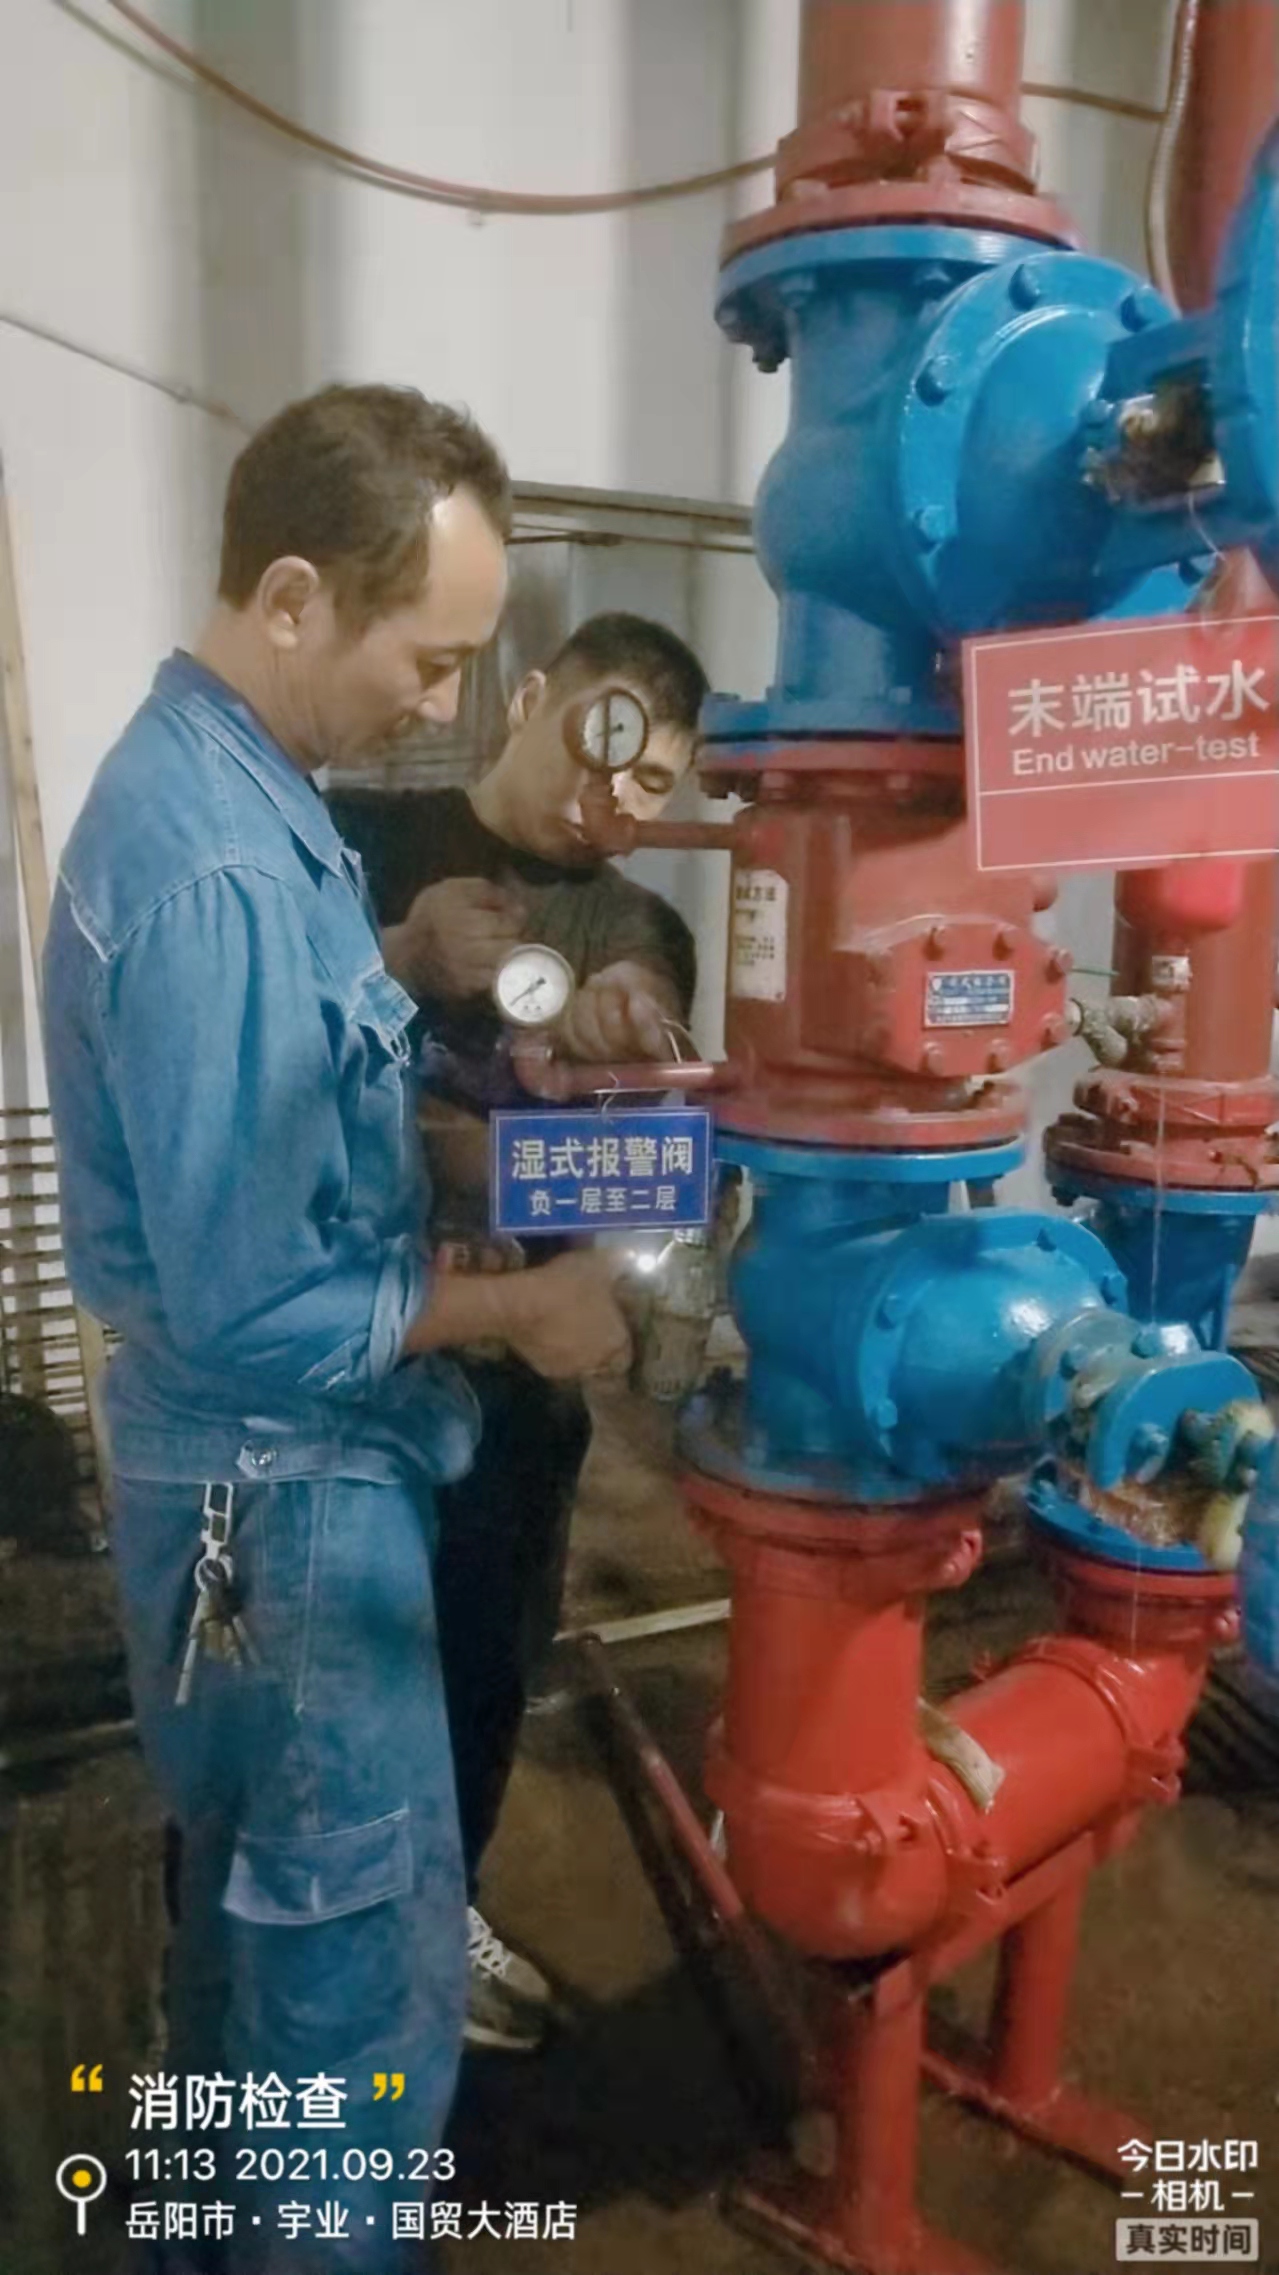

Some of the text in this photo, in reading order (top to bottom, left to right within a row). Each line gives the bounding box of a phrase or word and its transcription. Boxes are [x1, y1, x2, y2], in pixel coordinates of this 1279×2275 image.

[1007, 659, 1270, 738] 末端试水
[1012, 731, 1261, 776] End water-test
[511, 1136, 693, 1180] 湿式报警阀
[529, 1185, 677, 1217] 负一层至二层
